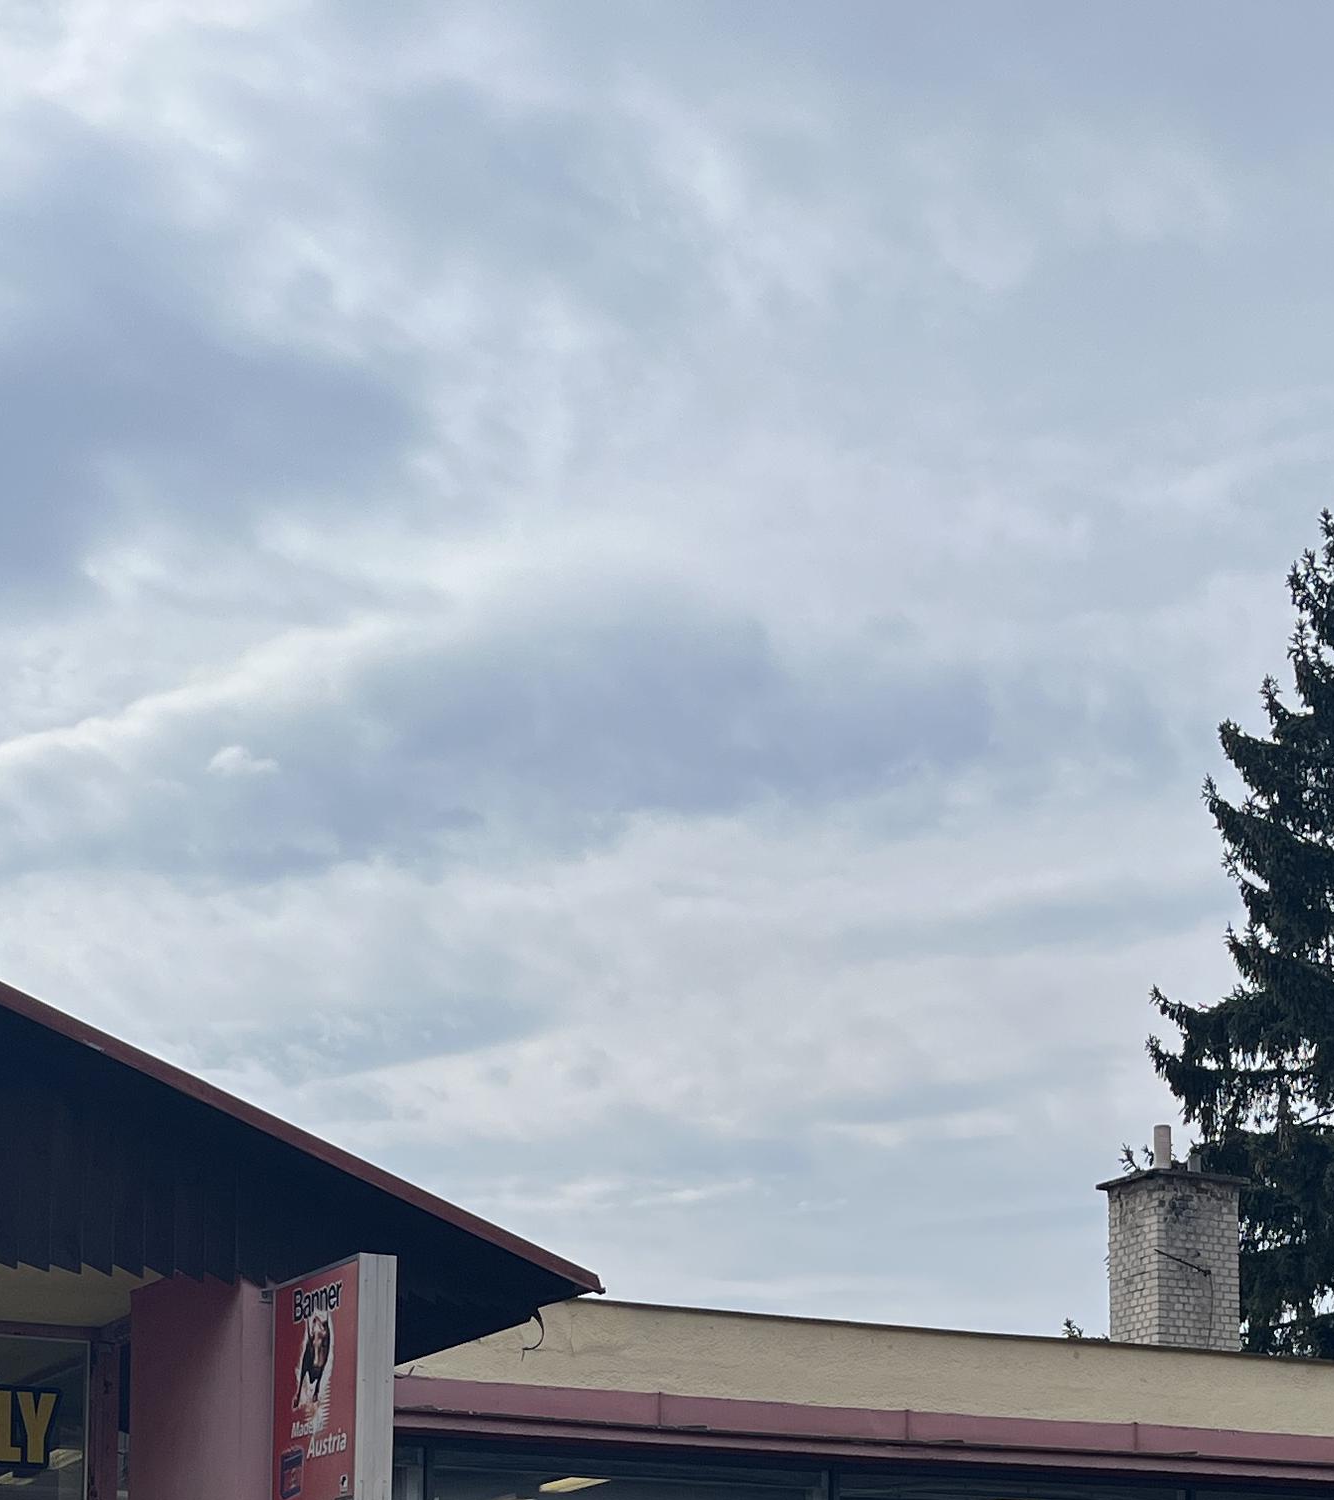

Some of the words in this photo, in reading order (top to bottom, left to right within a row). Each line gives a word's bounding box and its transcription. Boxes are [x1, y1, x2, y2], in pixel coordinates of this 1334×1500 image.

[293, 1281, 342, 1322] Banner
[291, 1420, 314, 1439] Made
[305, 1427, 348, 1460] Austria
